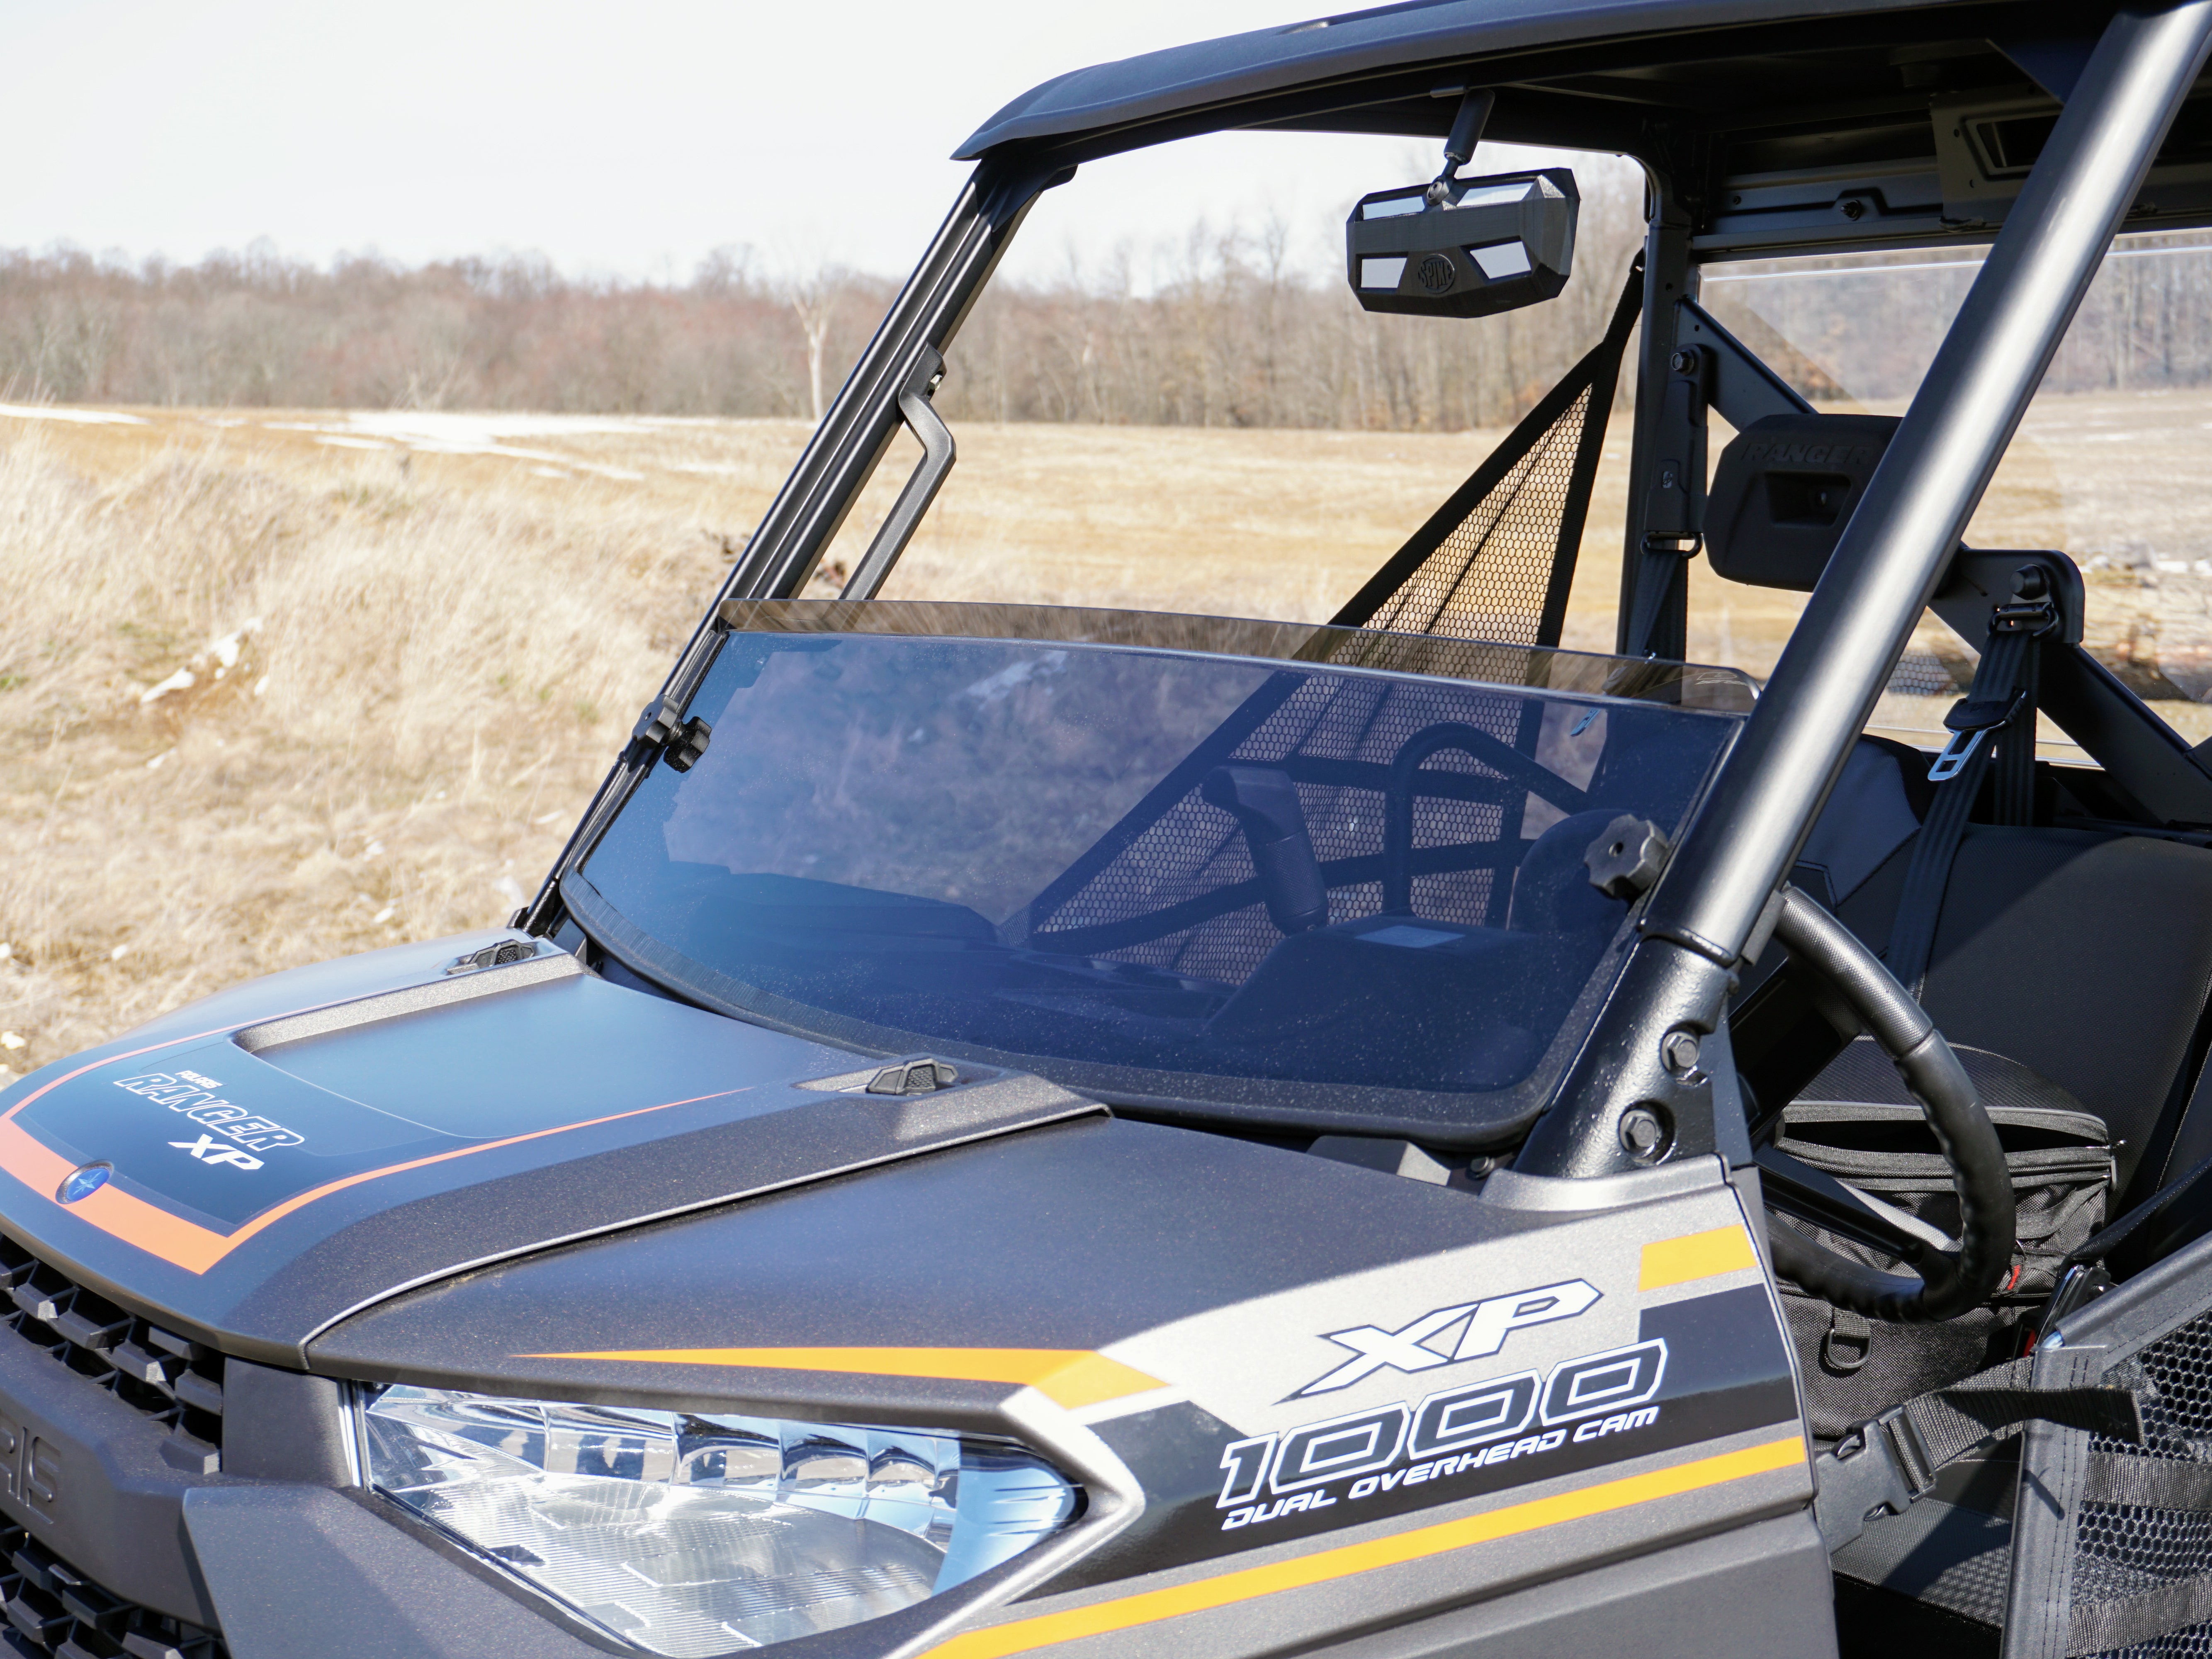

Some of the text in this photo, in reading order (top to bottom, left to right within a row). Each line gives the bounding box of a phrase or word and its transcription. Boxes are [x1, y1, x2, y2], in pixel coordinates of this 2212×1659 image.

[1417, 260, 1453, 289] SPIKE
[1741, 443, 1873, 465] RANGER
[175, 1070, 223, 1089] POLARIS
[113, 1073, 305, 1151] RANGER
[168, 1134, 265, 1170] XP
[1271, 1278, 1604, 1405] XP
[1215, 1338, 1668, 1508] 1000
[1221, 1406, 1660, 1531] DUAL OVERHEAD CAM
